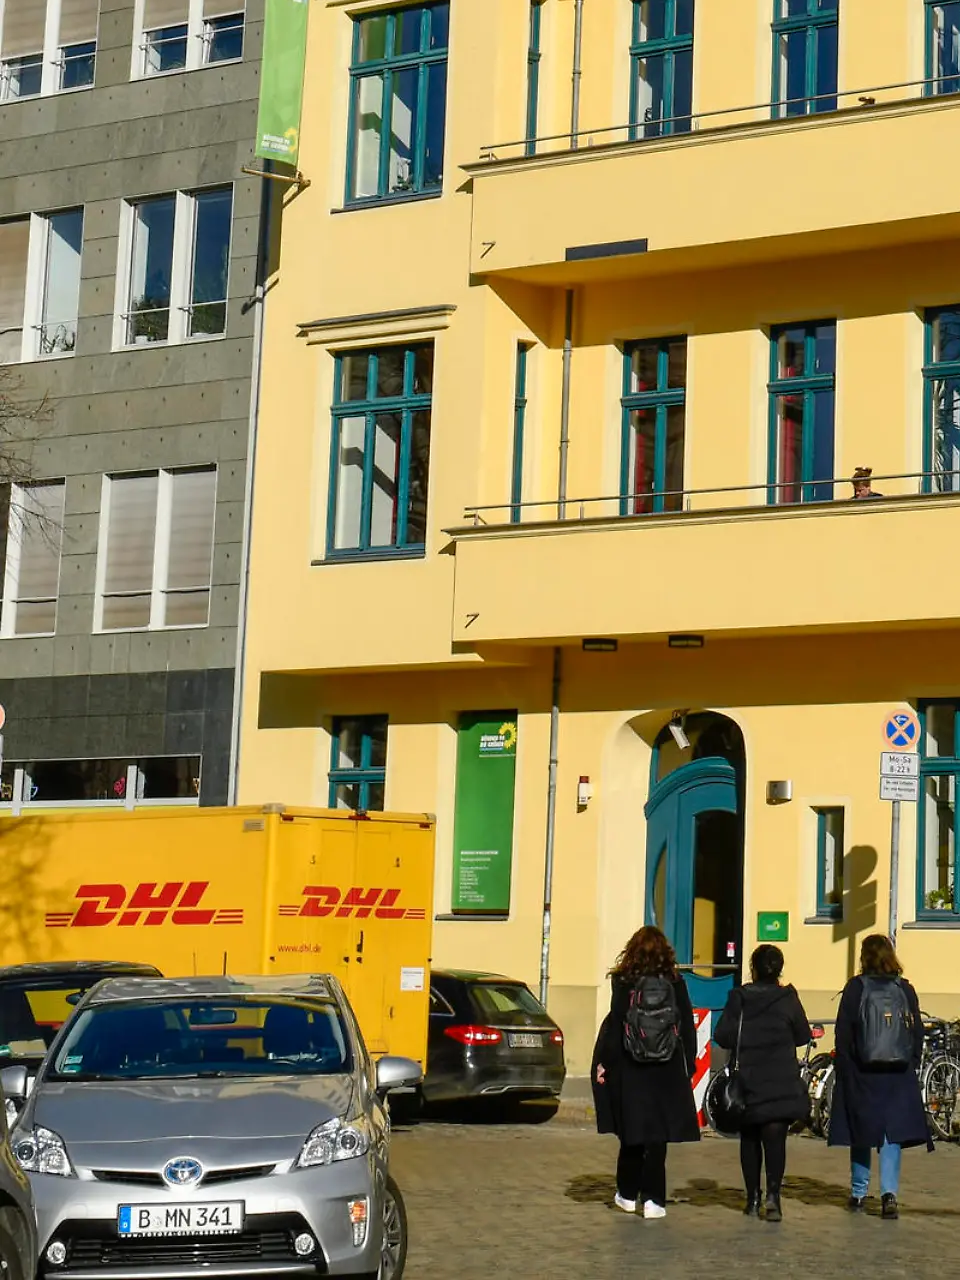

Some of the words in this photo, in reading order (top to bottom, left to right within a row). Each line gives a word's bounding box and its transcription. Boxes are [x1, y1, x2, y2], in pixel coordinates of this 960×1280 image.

[71, 881, 210, 927] DHL
[299, 886, 406, 919] DHL
[277, 943, 322, 953] www.dhl.de
[139, 1209, 151, 1228] B
[165, 1208, 191, 1228] MN
[196, 1207, 232, 1227] 341
